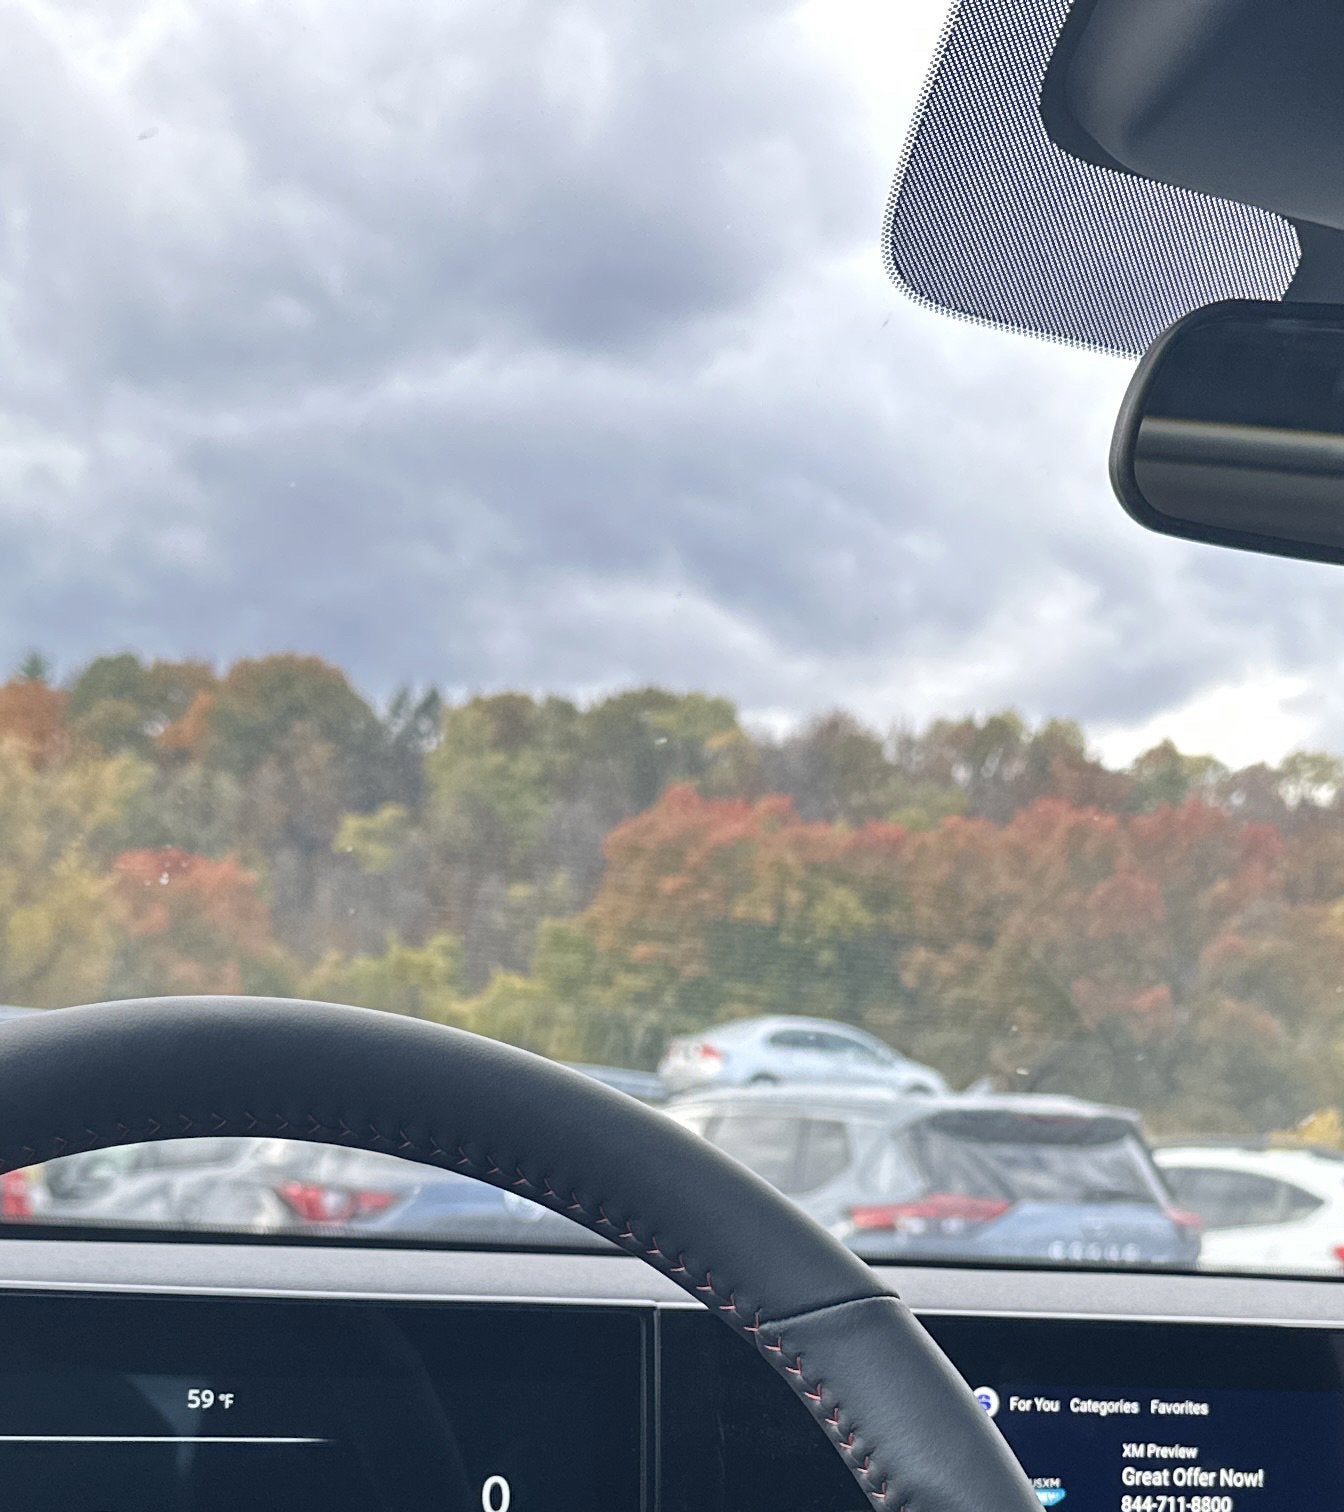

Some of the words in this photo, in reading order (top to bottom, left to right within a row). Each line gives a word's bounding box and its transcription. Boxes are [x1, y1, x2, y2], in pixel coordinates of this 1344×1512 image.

[187, 1389, 215, 1409] 59
[1009, 1396, 1033, 1412] For
[1035, 1396, 1060, 1412] You
[1069, 1398, 1140, 1416] Categories
[1150, 1399, 1210, 1416] Favorites
[1121, 1443, 1145, 1459] XM
[1146, 1443, 1199, 1459] Preview
[1121, 1467, 1170, 1487] Great
[1172, 1467, 1218, 1488] Offer
[1220, 1468, 1265, 1488] Now!
